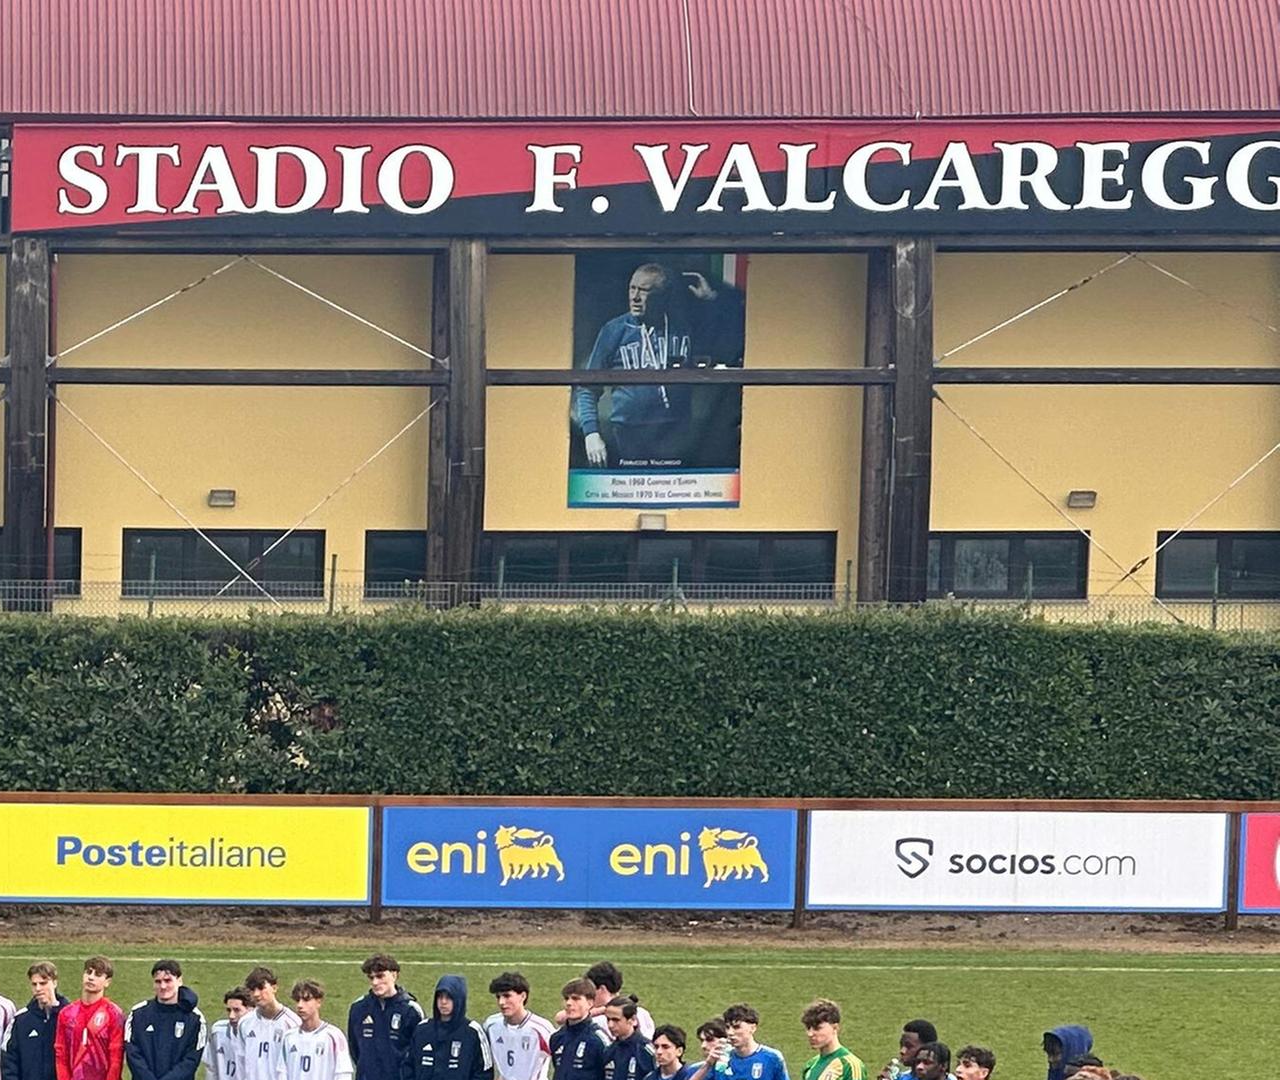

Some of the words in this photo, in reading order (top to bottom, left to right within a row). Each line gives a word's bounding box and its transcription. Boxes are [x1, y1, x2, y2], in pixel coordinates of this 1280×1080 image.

[56, 143, 455, 216] STADIO
[526, 143, 610, 215] F.
[633, 139, 1280, 213] VALCAREGG
[56, 835, 287, 868] Posteitaliane
[406, 830, 487, 875] eni
[609, 831, 690, 876] eni
[948, 852, 1137, 877] socios.com
[507, 1050, 514, 1067] 6
